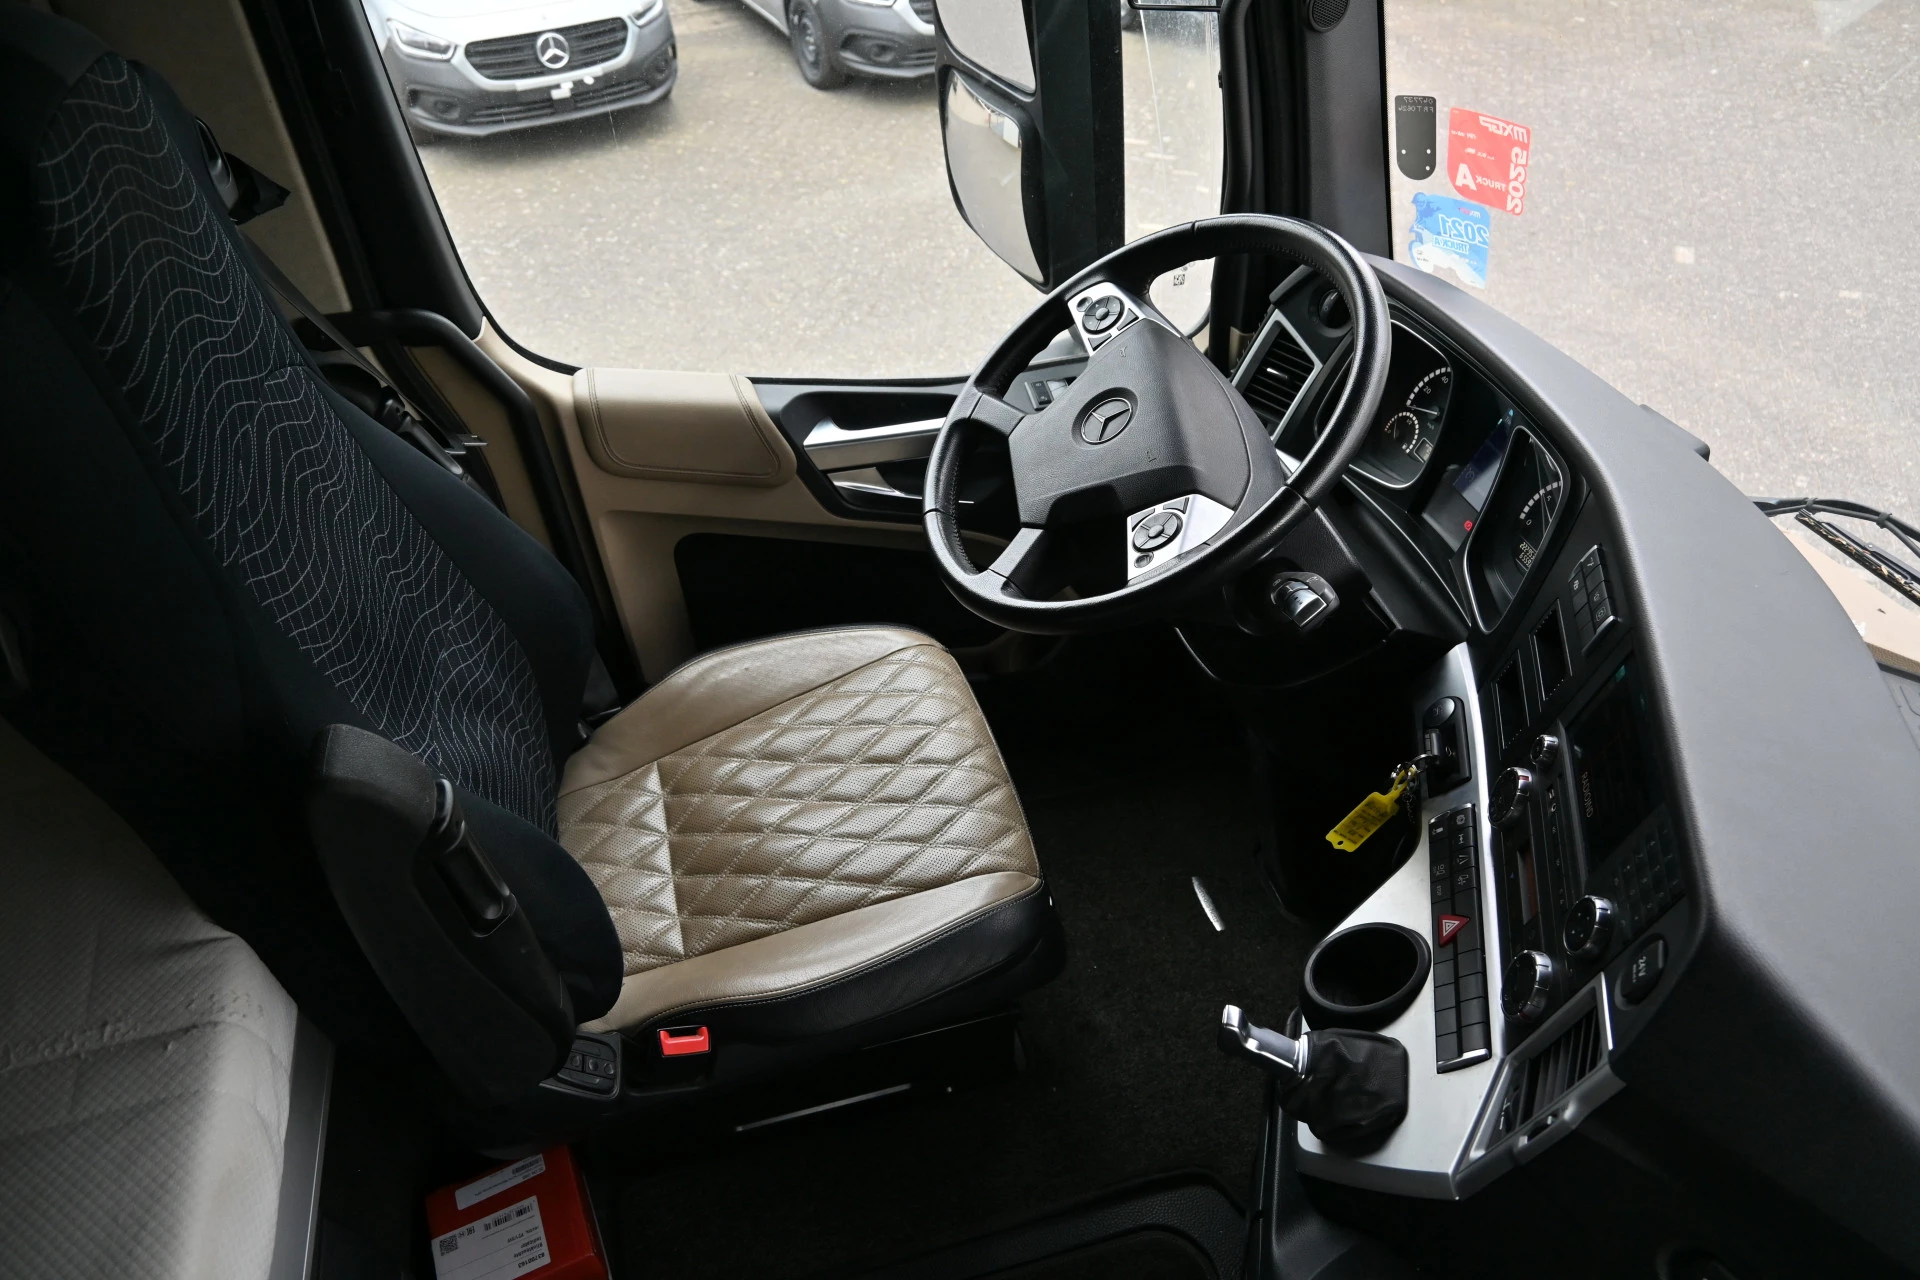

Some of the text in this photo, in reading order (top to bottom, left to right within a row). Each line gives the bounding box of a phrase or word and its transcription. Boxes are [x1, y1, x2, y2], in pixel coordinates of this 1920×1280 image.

[1441, 376, 1449, 384] 40
[1423, 386, 1432, 394] 20
[1638, 955, 1647, 977] 24V
